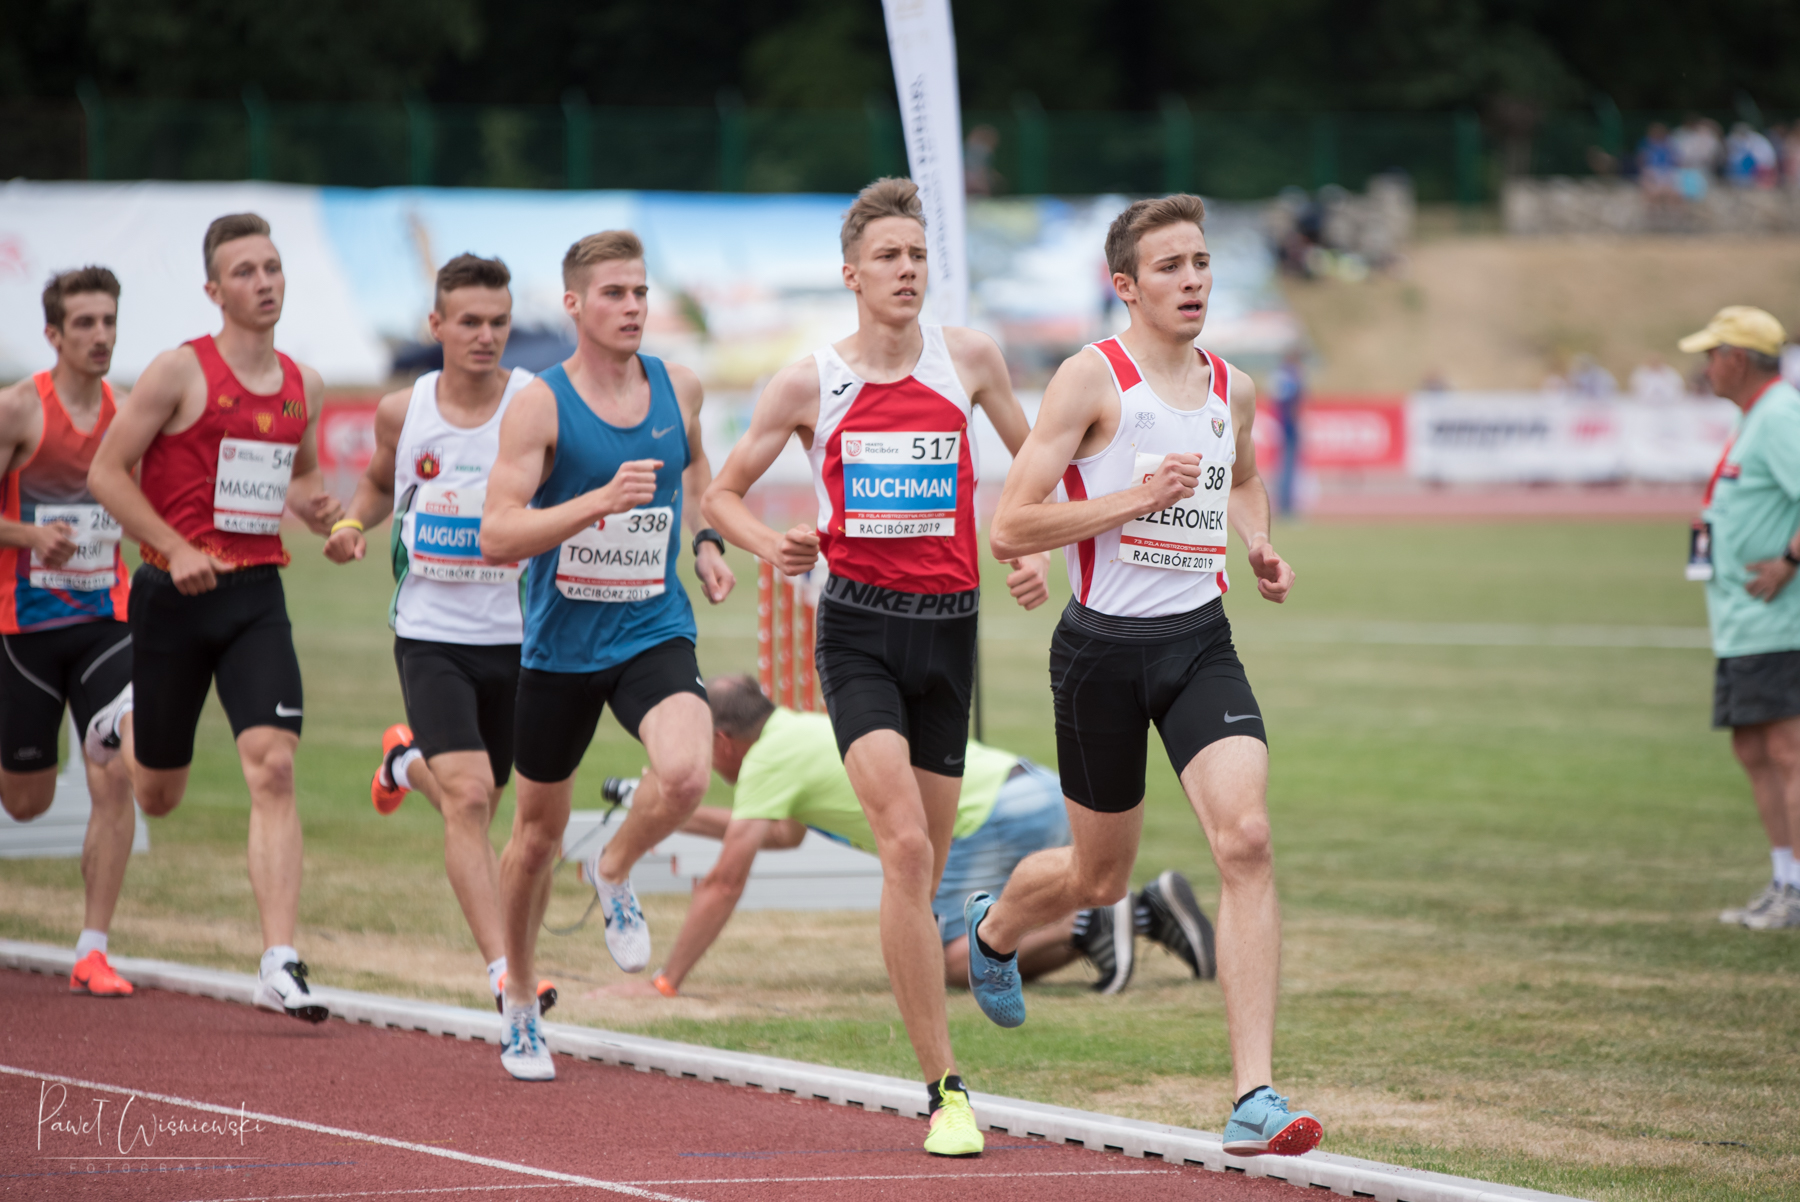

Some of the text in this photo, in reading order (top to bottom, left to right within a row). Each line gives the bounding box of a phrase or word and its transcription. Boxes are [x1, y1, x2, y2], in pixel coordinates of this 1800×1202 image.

[865, 446, 899, 454] Racibórz
[911, 437, 956, 460] 517
[852, 477, 953, 498] KUCHMAN
[628, 512, 668, 533] 338
[860, 520, 941, 535] RACIBÓRZ 2019
[417, 524, 481, 548] AUGUSTY
[568, 545, 661, 567] TOMASIAK
[1133, 550, 1214, 569] RACIBÓRZ 2019
[423, 564, 505, 580] RACIBÓRZ 2019
[567, 586, 651, 600] RACIBÓRZ 2019
[839, 580, 913, 614] NIKE
[915, 589, 975, 616] PRO
